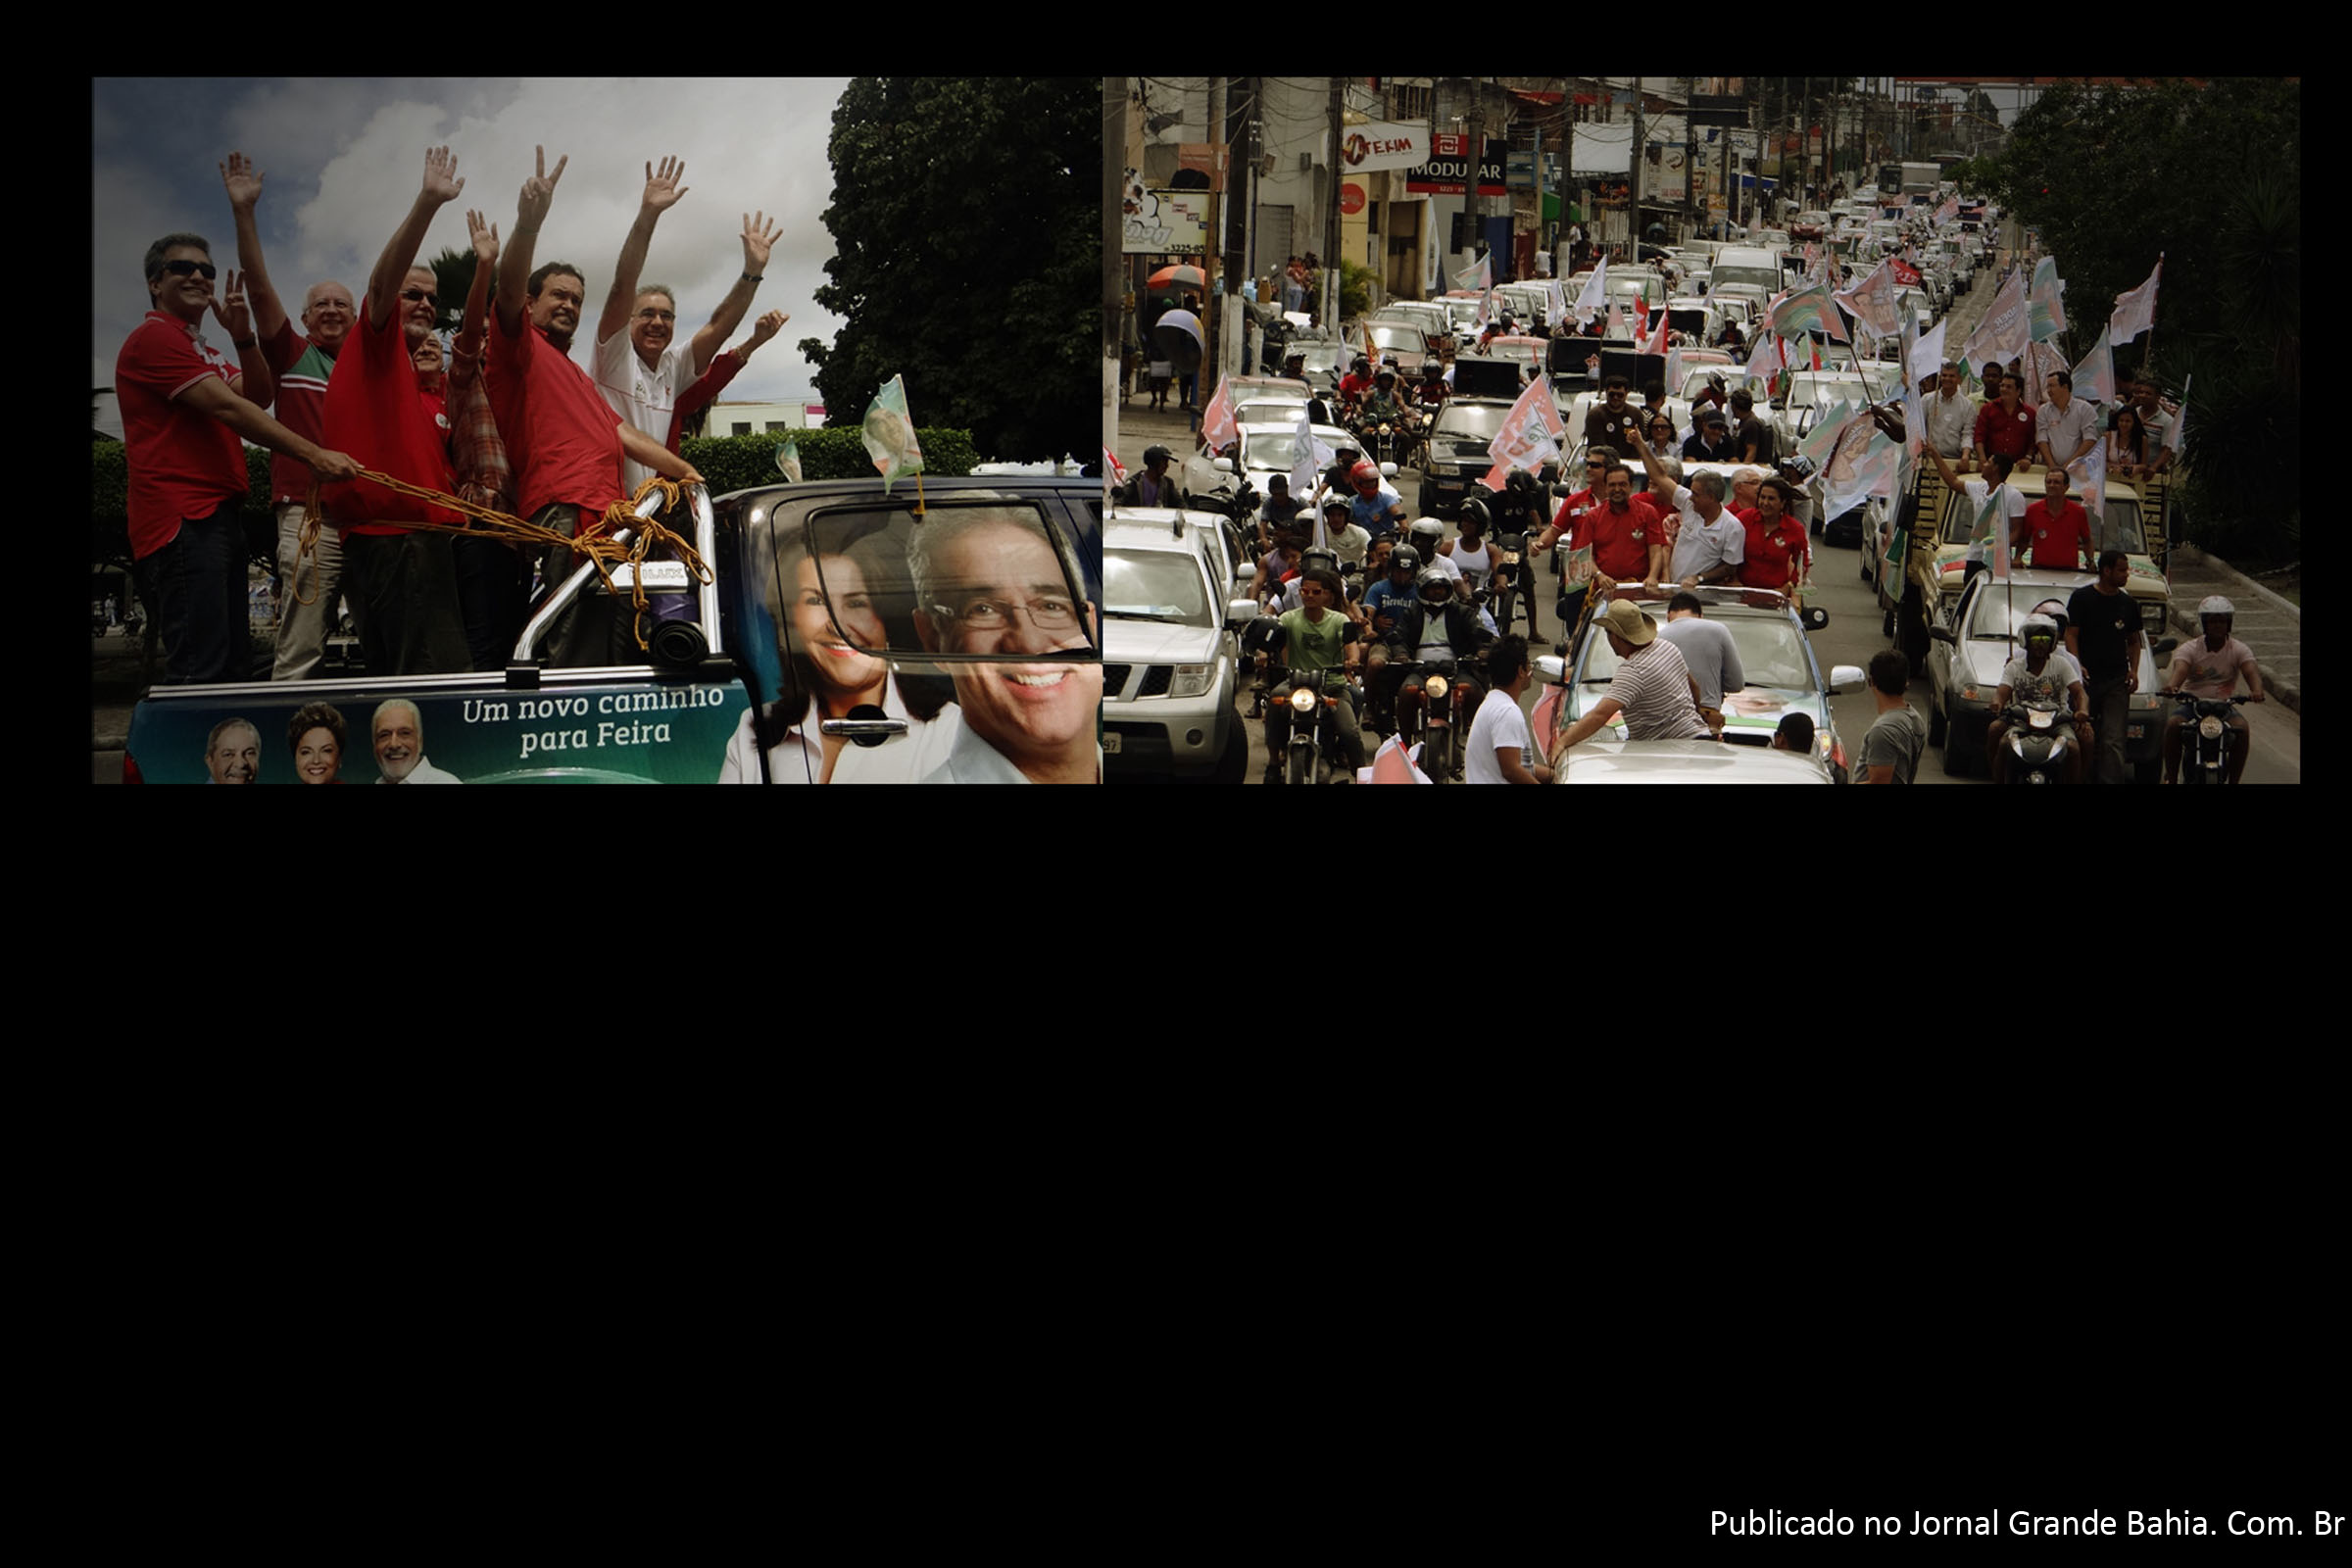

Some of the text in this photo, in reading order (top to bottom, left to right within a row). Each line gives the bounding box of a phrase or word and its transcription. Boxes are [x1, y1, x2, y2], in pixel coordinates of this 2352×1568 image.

[1410, 162, 1501, 179] MODUAR
[1171, 244, 1208, 253] 3225-85
[464, 685, 724, 723] Um novo caminho
[519, 720, 672, 760] para Feira
